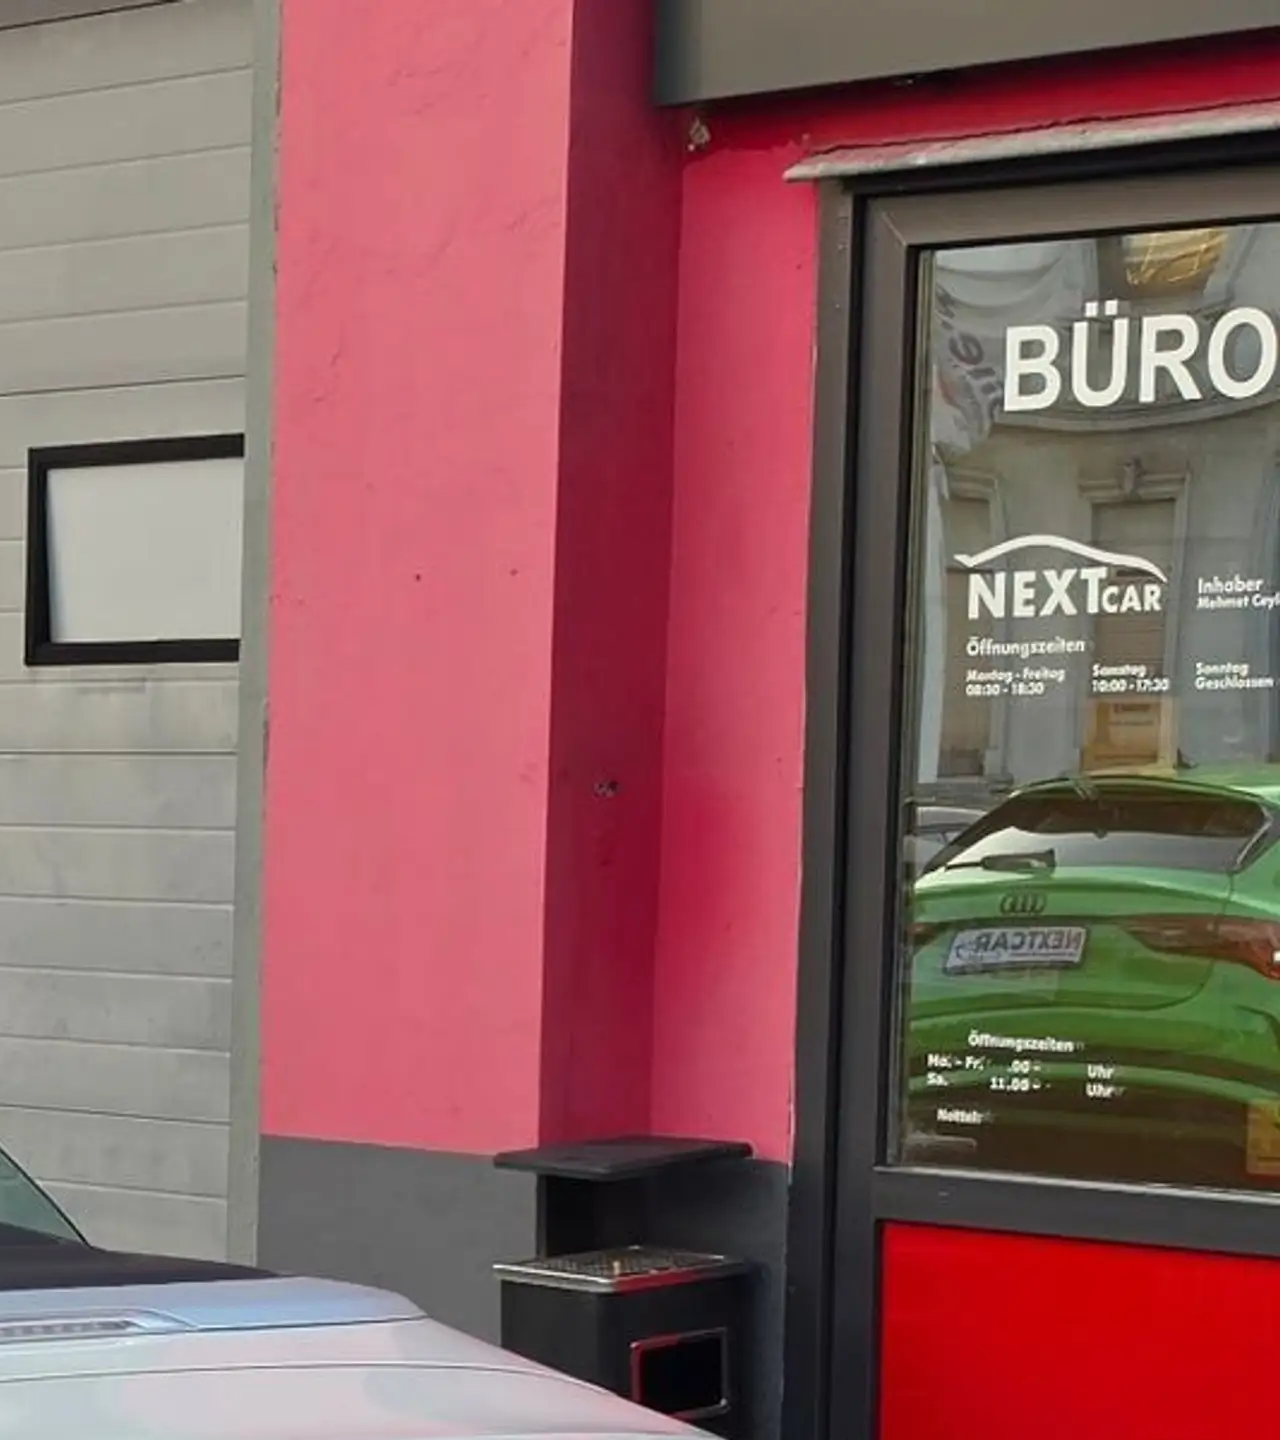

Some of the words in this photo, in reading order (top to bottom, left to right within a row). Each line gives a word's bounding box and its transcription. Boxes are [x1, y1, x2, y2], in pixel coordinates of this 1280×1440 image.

[1004, 300, 1278, 411] BÜRO
[1198, 574, 1264, 594] Inhaber
[966, 636, 1085, 658] Öffnungszeiten
[1022, 667, 1066, 682] Freitag
[1196, 662, 1249, 677] Sonntag
[968, 1030, 1074, 1052] Öffnungszeiten
[1087, 1064, 1114, 1080] Uhr
[1086, 1082, 1114, 1097] Uhr
